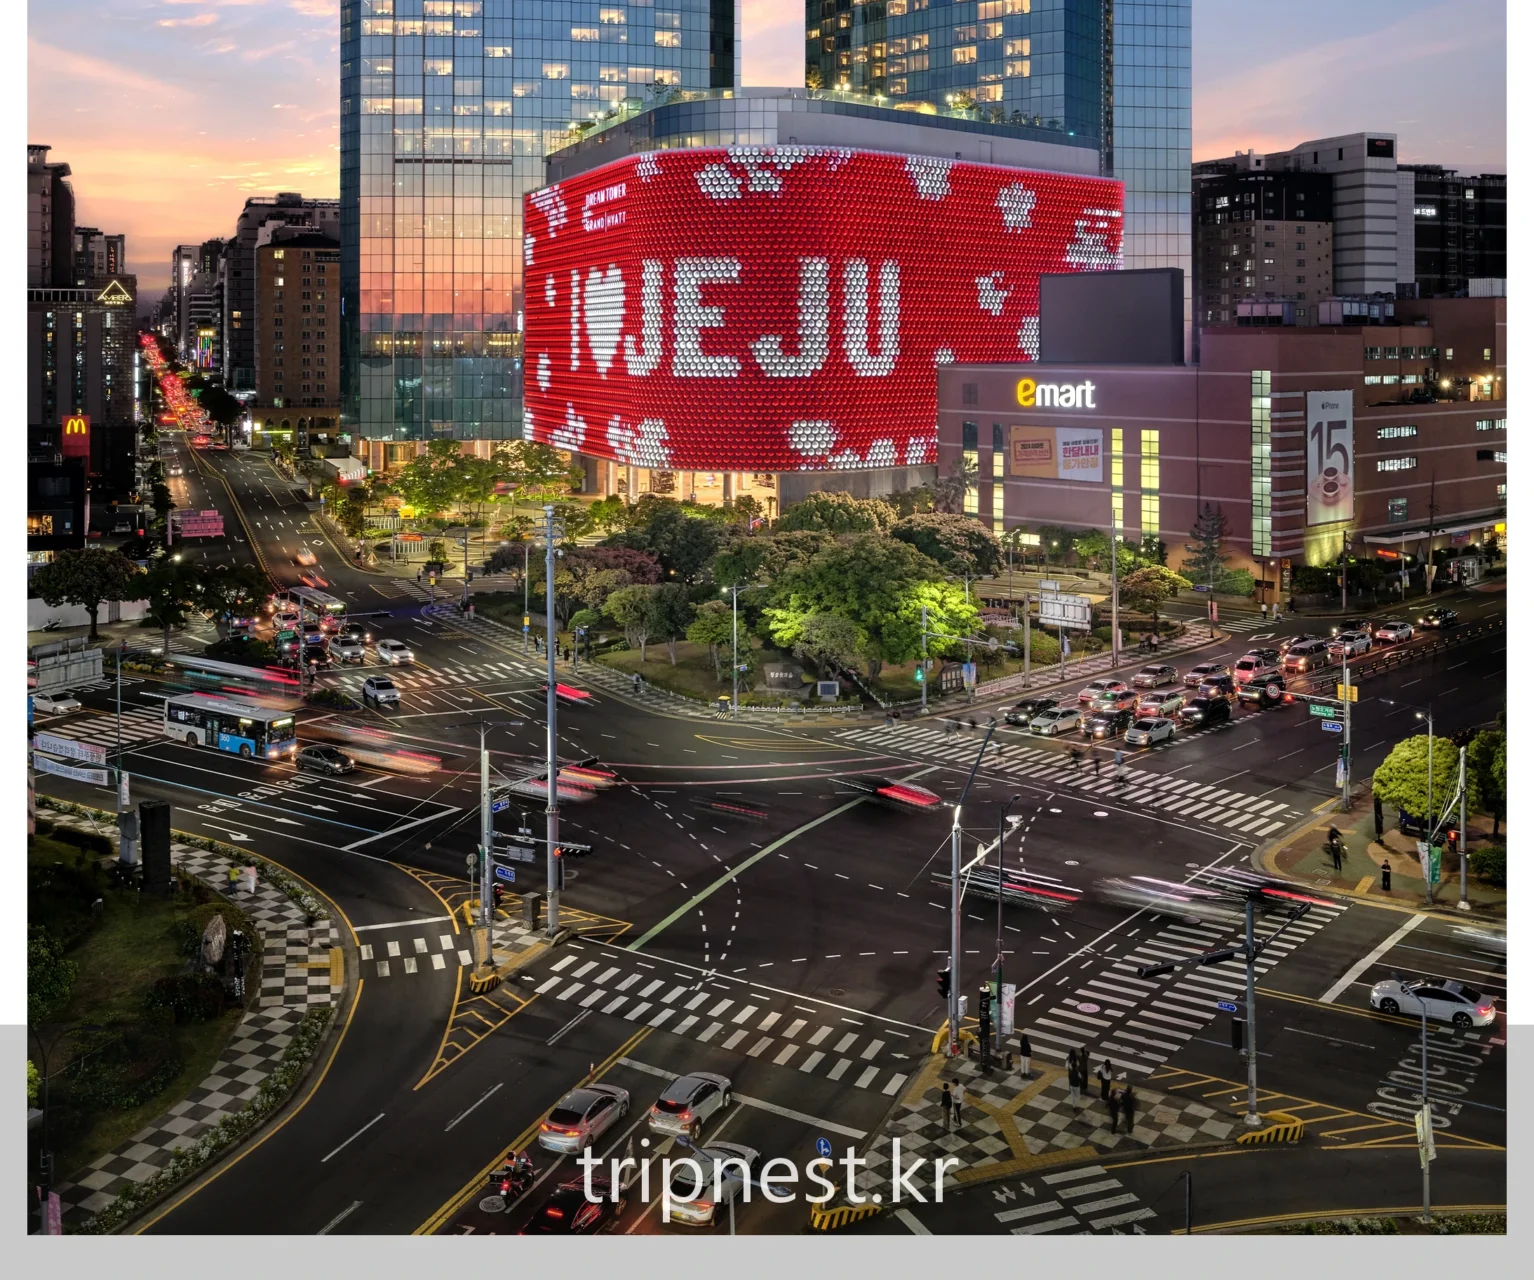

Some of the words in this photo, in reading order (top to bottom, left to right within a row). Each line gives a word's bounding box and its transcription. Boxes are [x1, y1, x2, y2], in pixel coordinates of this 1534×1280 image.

[585, 189, 605, 207] DREAM
[606, 183, 626, 201] TOWER
[607, 211, 626, 227] HYATT
[1017, 378, 1096, 409] emart
[1324, 402, 1339, 410] iPhone
[1311, 420, 1349, 477] 15
